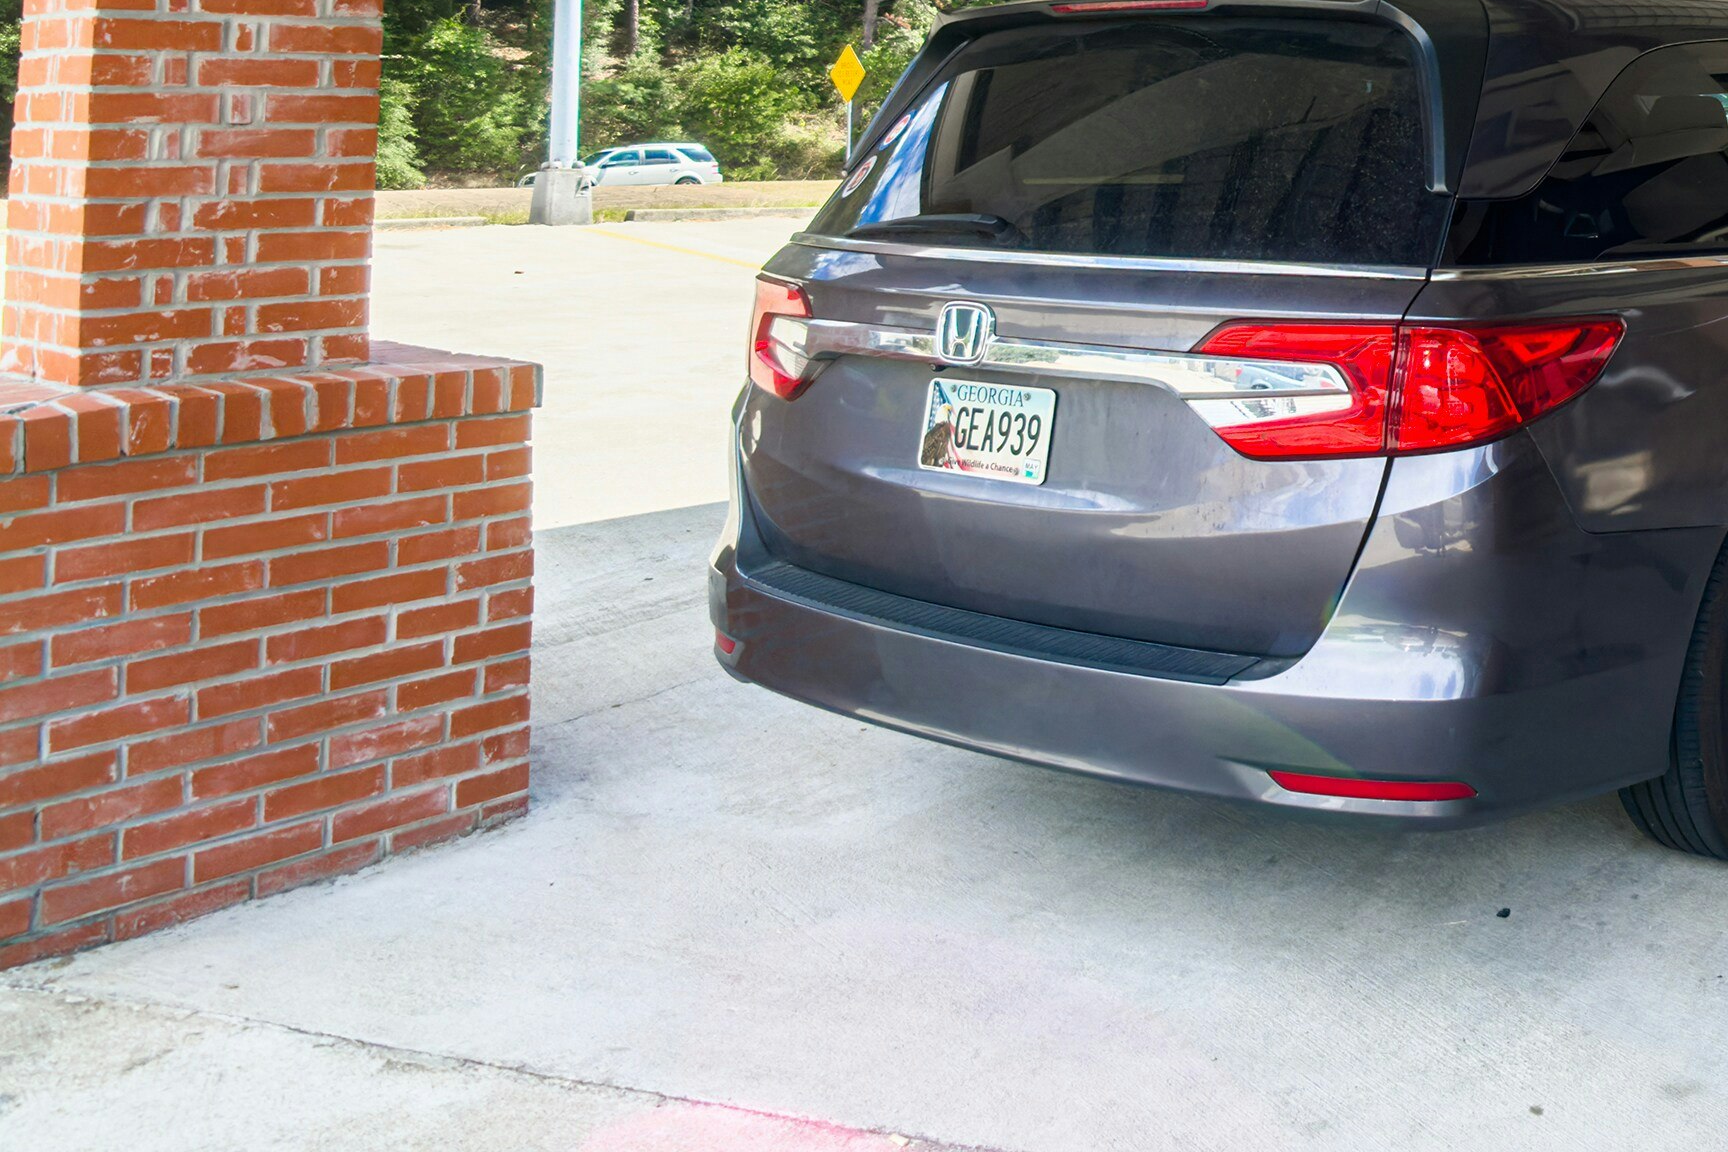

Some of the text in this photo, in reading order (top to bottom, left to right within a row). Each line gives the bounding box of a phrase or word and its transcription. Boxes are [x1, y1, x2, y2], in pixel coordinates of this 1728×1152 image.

[957, 384, 1025, 407] GEORGIA
[954, 406, 1042, 457] GEA939
[990, 462, 1013, 474] Chance
[1025, 462, 1038, 470] MAY
